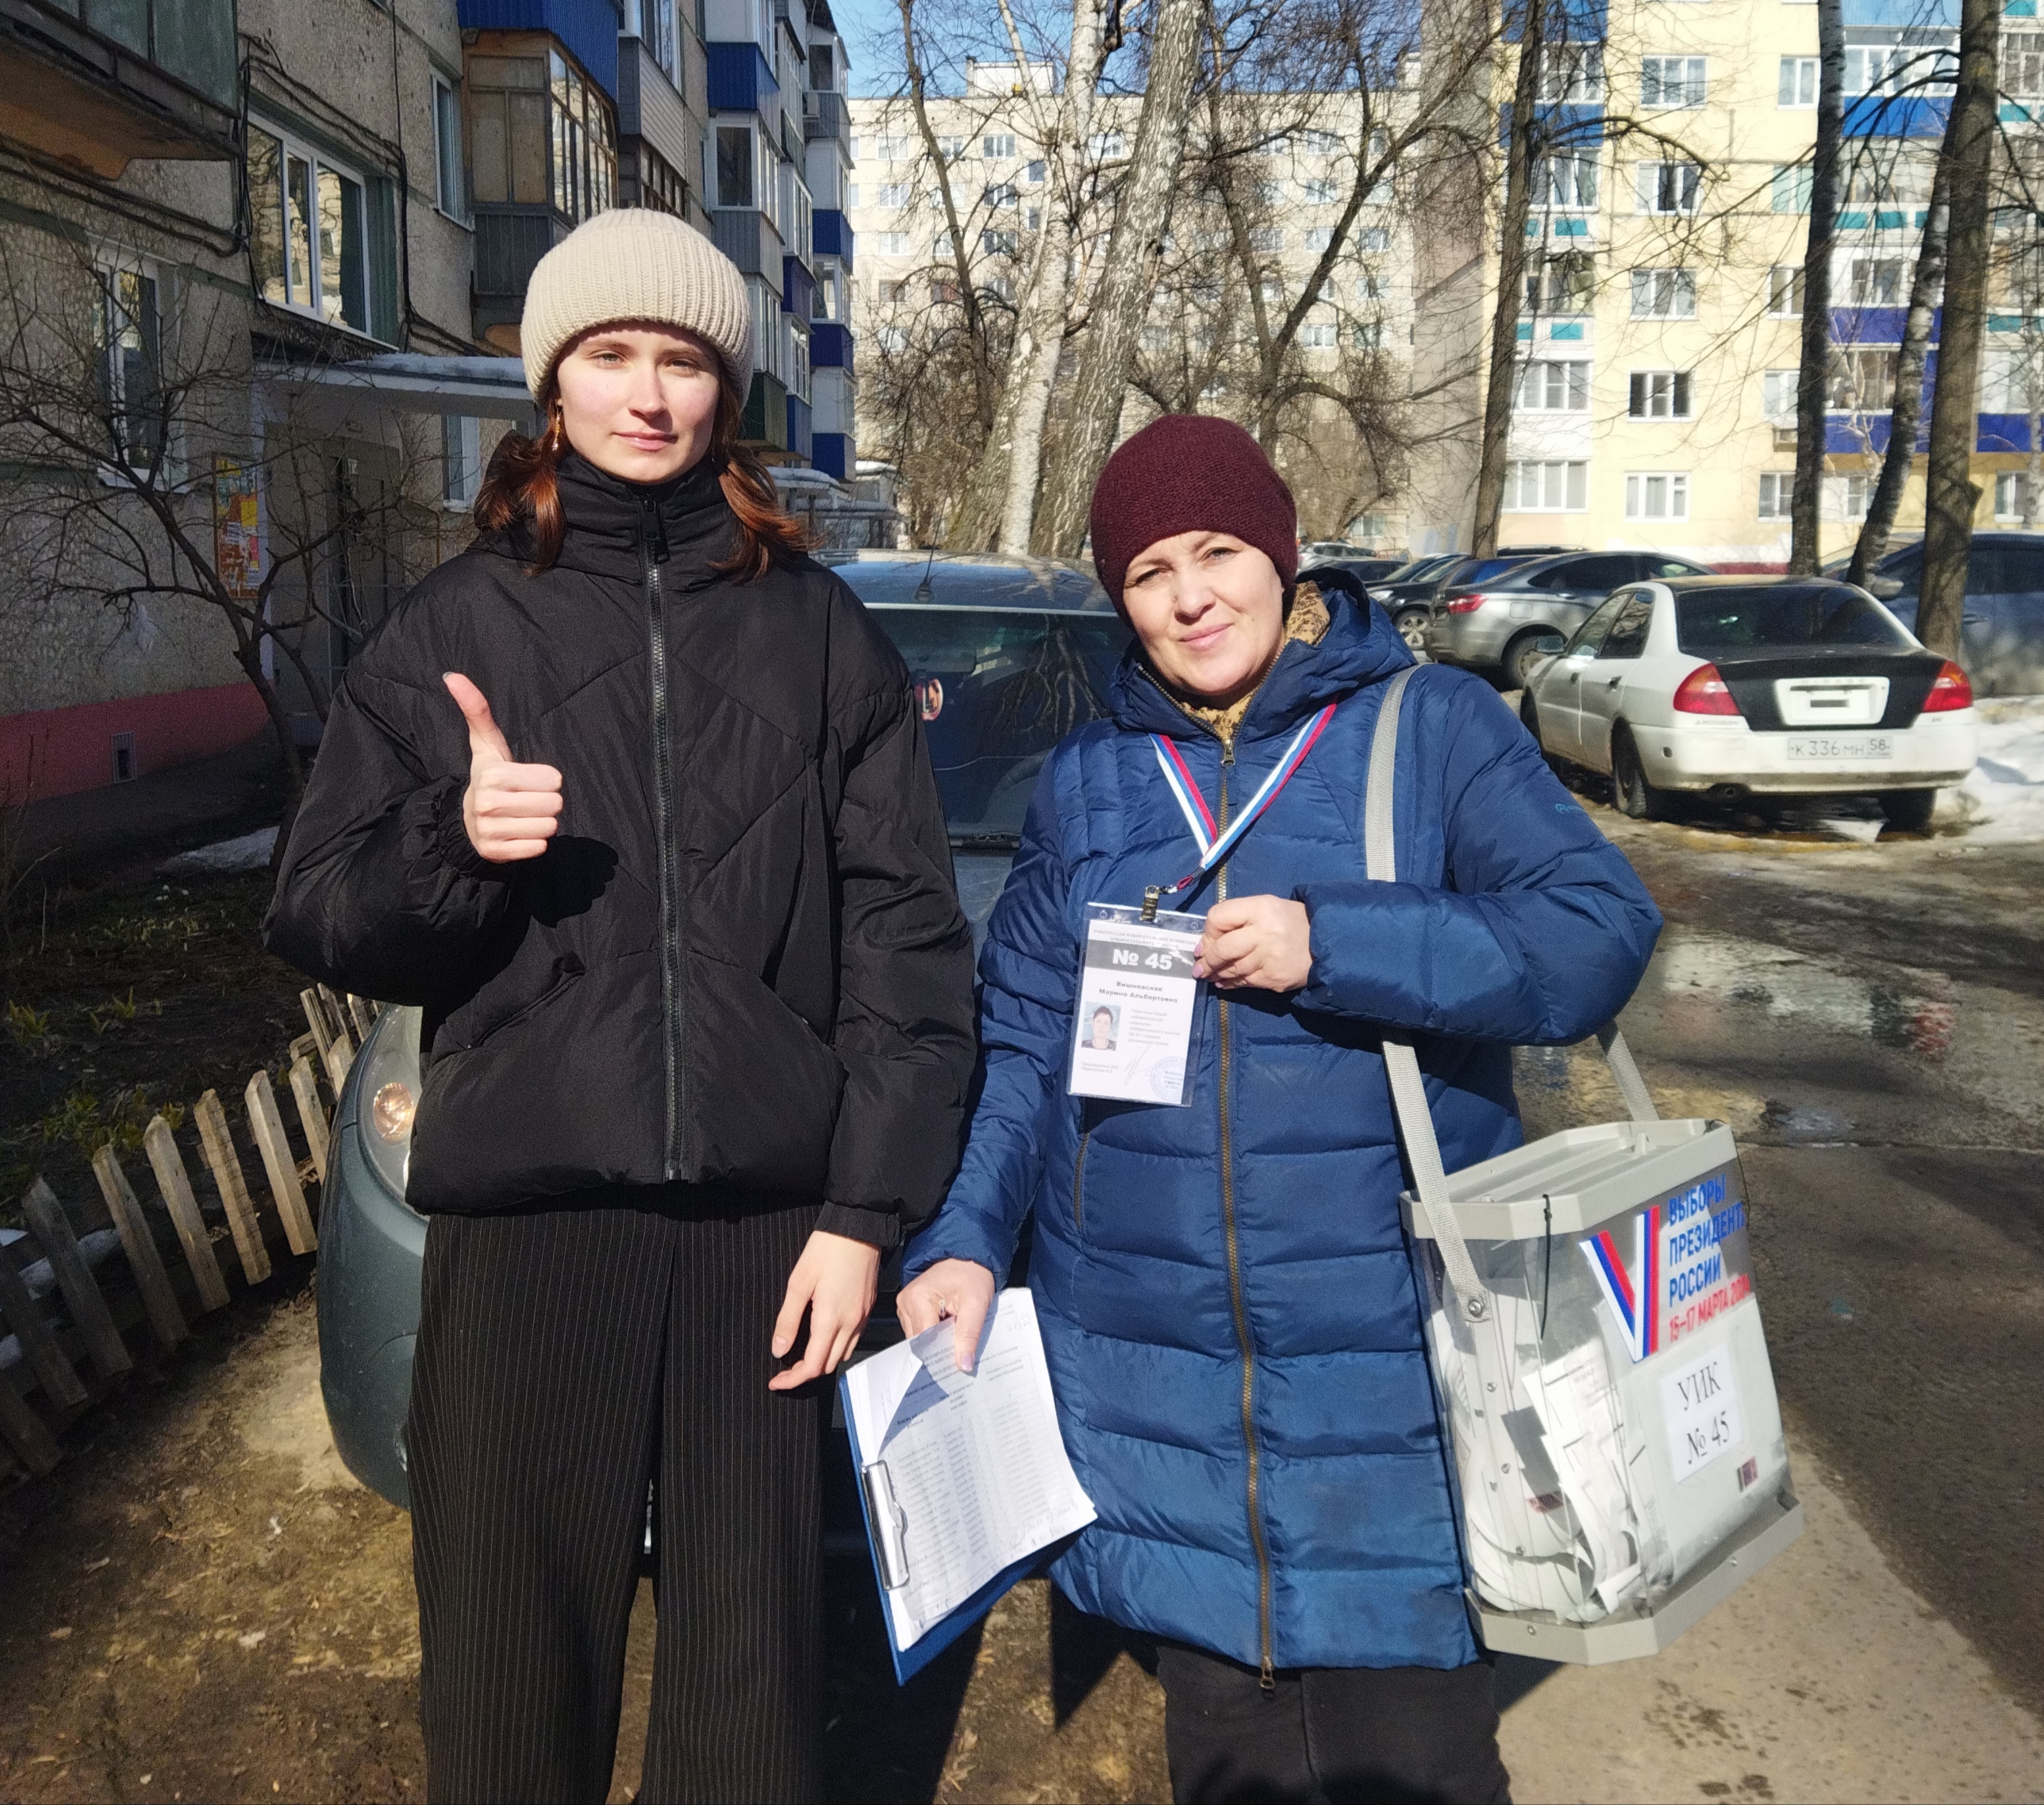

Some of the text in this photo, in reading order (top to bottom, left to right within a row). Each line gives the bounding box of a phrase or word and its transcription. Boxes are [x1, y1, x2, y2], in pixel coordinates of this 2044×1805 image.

[1112, 948, 1172, 970] № 45
[1099, 989, 1178, 1003] Марина Альбертовна
[1116, 981, 1163, 992] Вишневская
[1668, 1174, 1726, 1227] ВЫБОРЫ
[1669, 1253, 1721, 1308] РОССИИ
[1698, 1287, 1728, 1327] МАРТА
[1677, 1362, 1721, 1411] УИК
[1687, 1410, 1729, 1465] № 45
